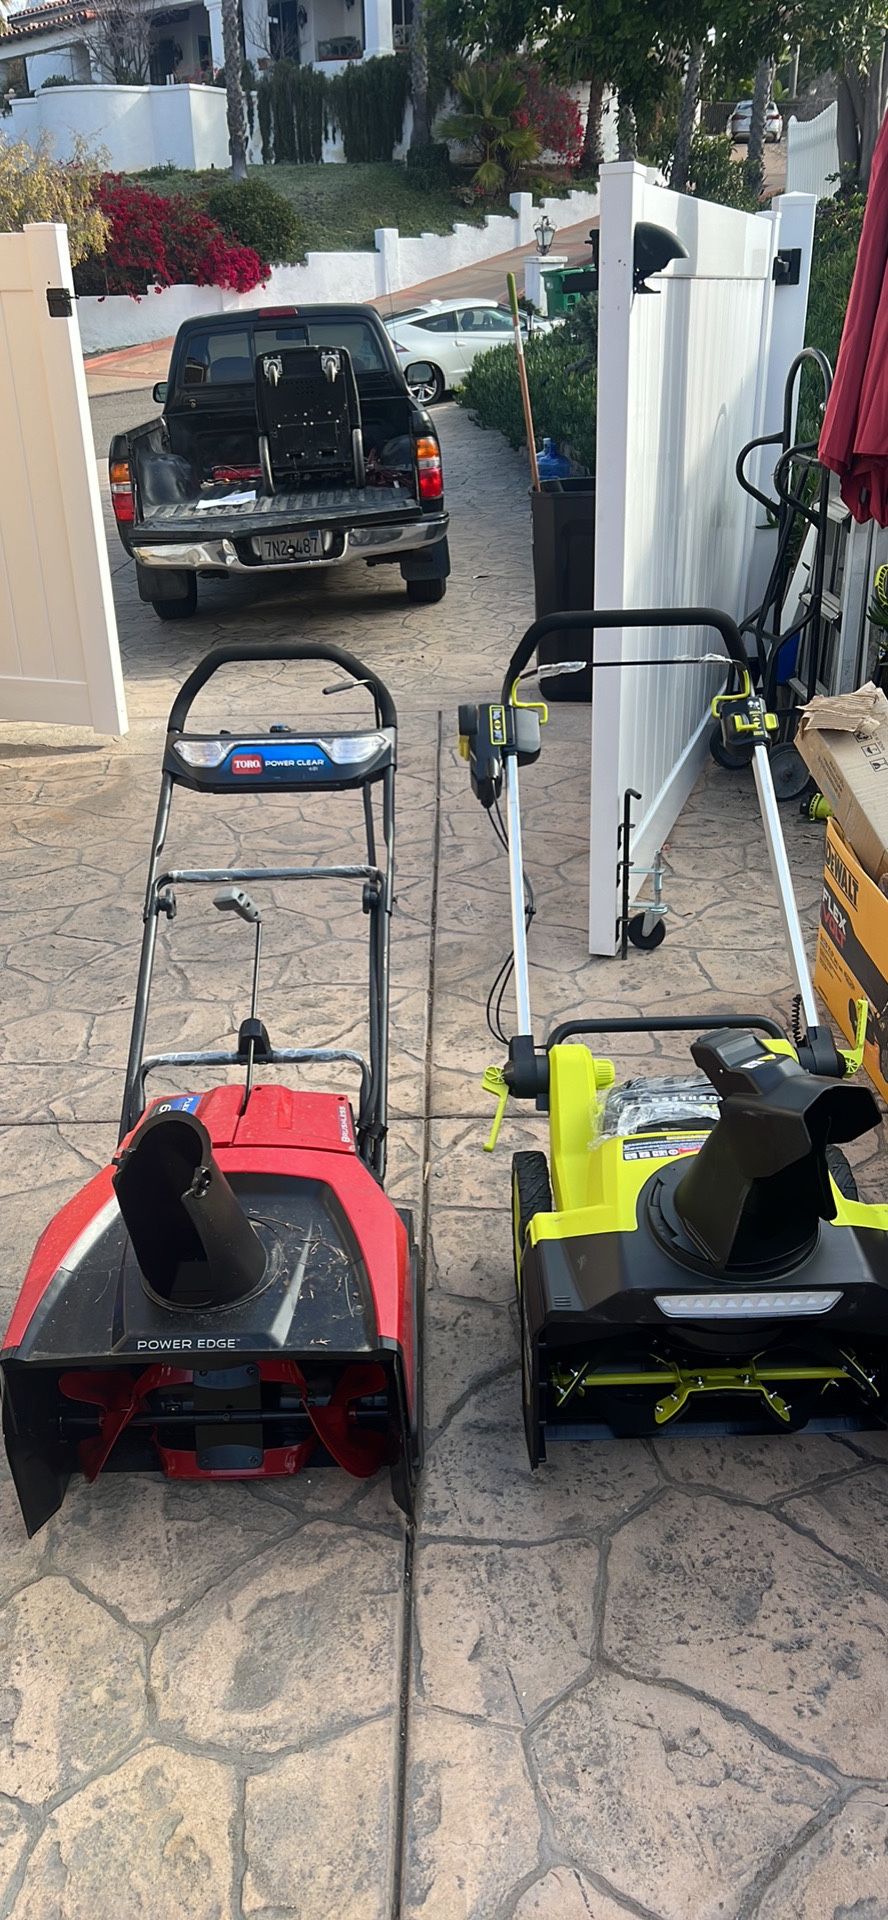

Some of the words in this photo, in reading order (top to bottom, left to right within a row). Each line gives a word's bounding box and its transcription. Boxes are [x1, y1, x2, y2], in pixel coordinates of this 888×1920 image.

[234, 759, 261, 769] TORO
[264, 759, 295, 767] POWER
[296, 758, 325, 766] CLEAR
[822, 887, 847, 936] FLEX
[821, 901, 846, 948] VOLT
[137, 1339, 192, 1350] POWER
[197, 1338, 236, 1349] EDGE
